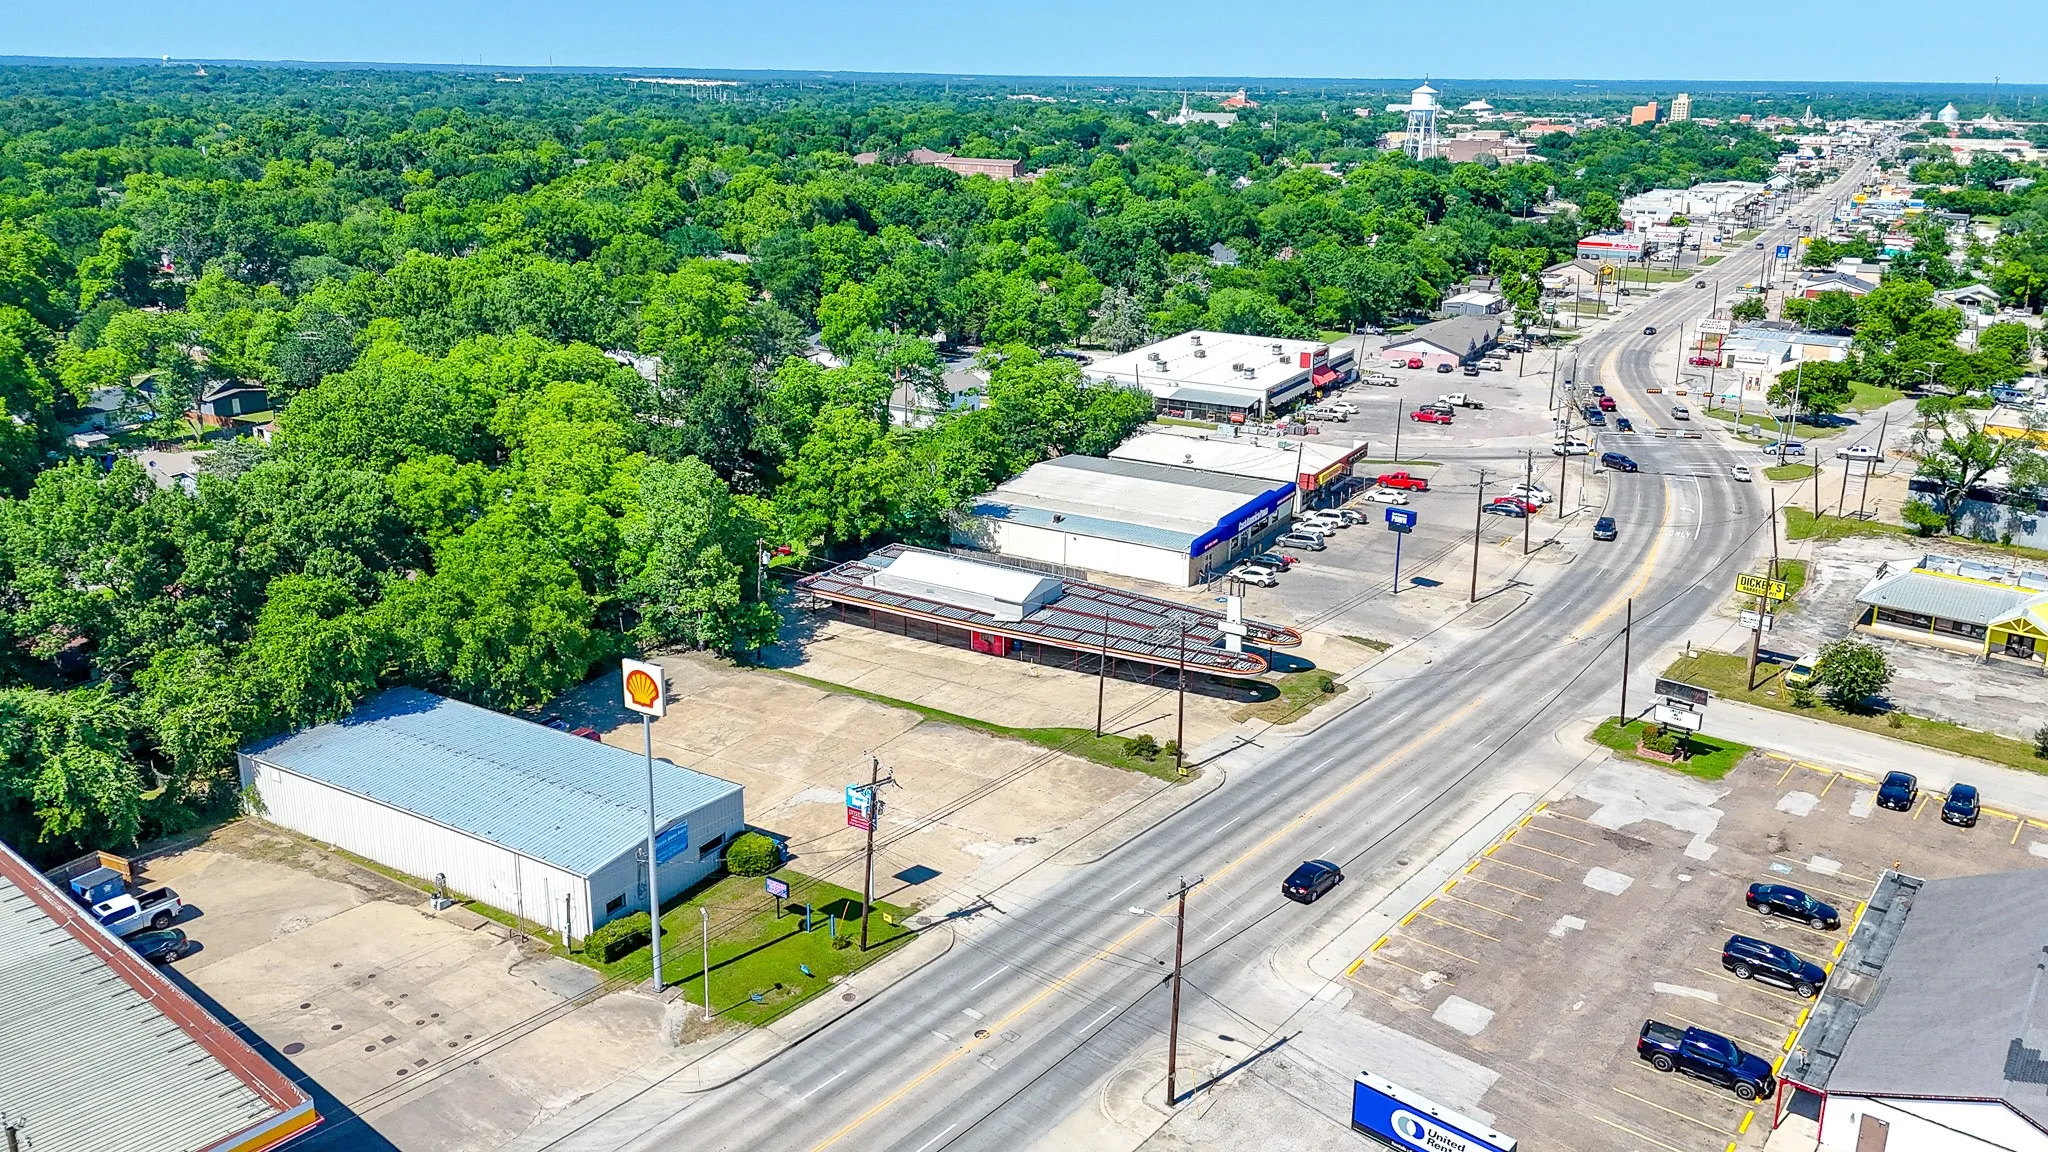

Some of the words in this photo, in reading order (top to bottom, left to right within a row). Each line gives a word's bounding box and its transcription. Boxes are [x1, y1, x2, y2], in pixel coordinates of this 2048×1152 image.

[1669, 529, 1691, 539] ONLY
[1740, 576, 1783, 593] DICKEY'S
[1742, 585, 1767, 596] BARBECU
[1427, 1128, 1466, 1152] United
